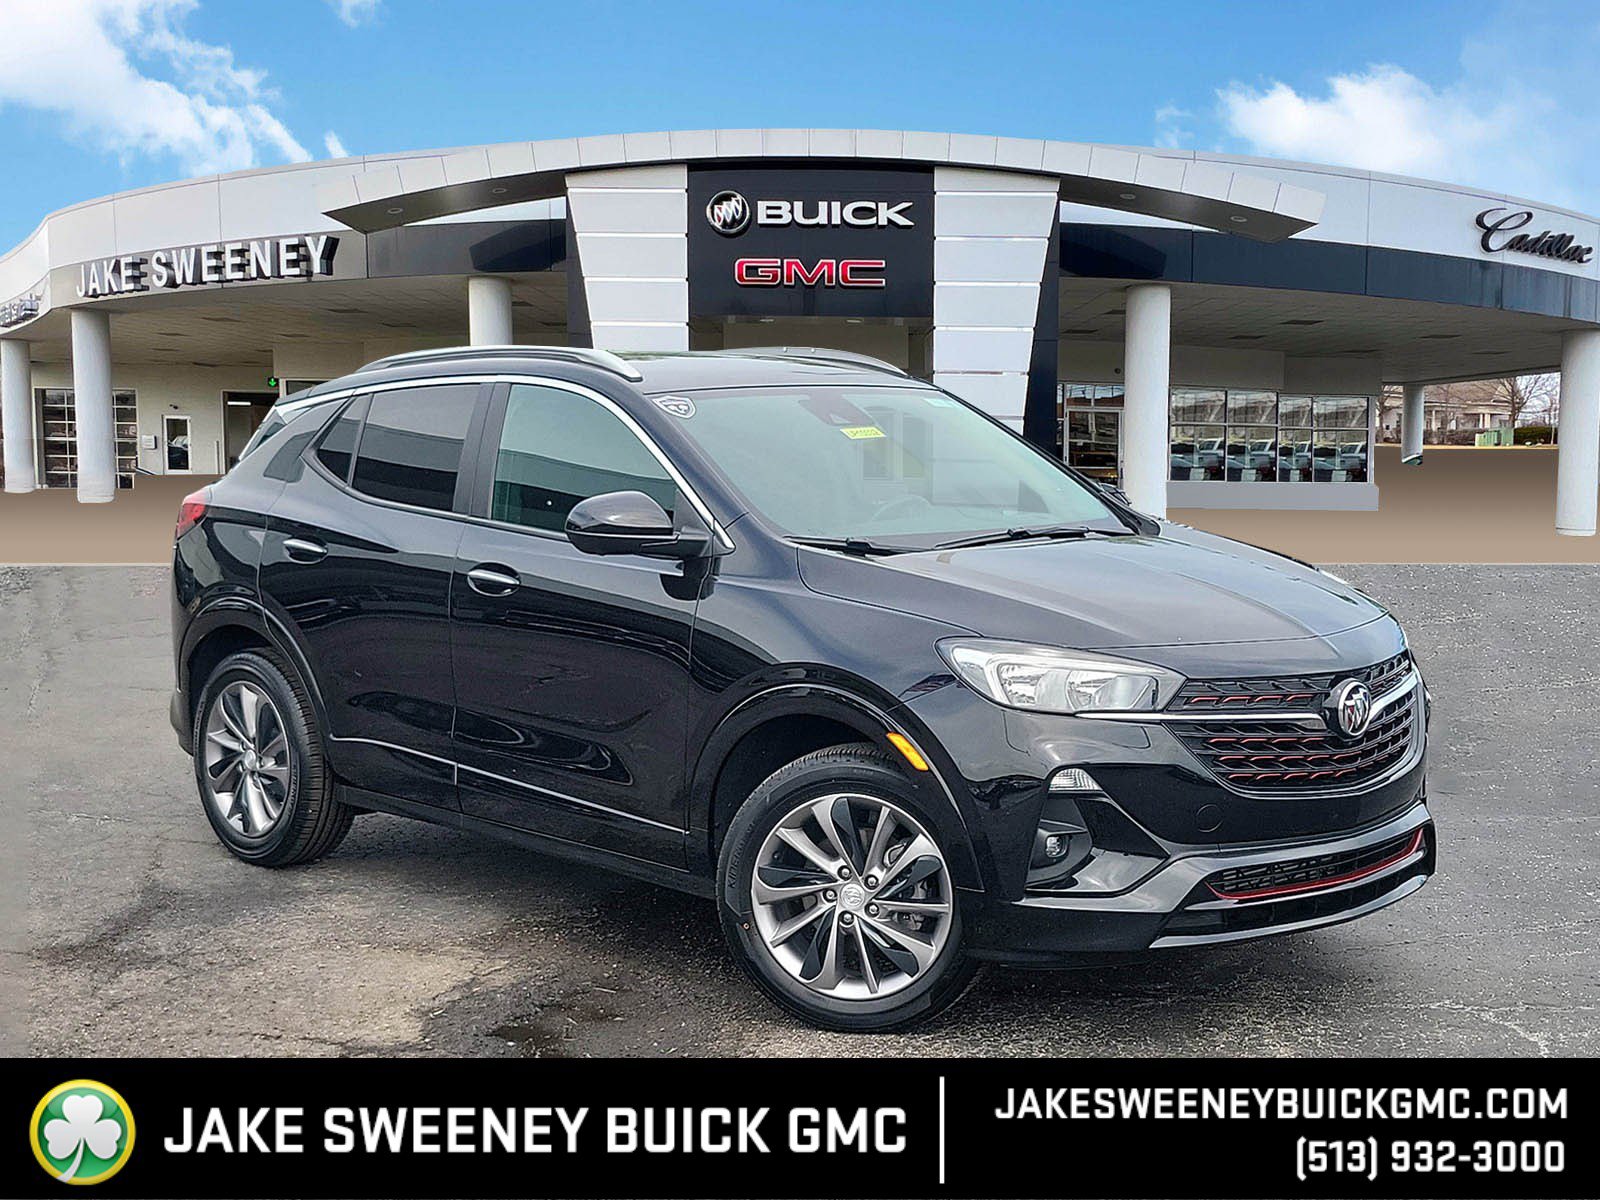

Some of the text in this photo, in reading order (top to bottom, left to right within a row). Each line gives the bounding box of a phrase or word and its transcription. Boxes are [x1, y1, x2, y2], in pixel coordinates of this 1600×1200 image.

[758, 200, 915, 226] BUICK
[1475, 207, 1593, 264] Cadillac
[76, 235, 339, 298] JAKE SWEENEY
[734, 258, 886, 287] GMC
